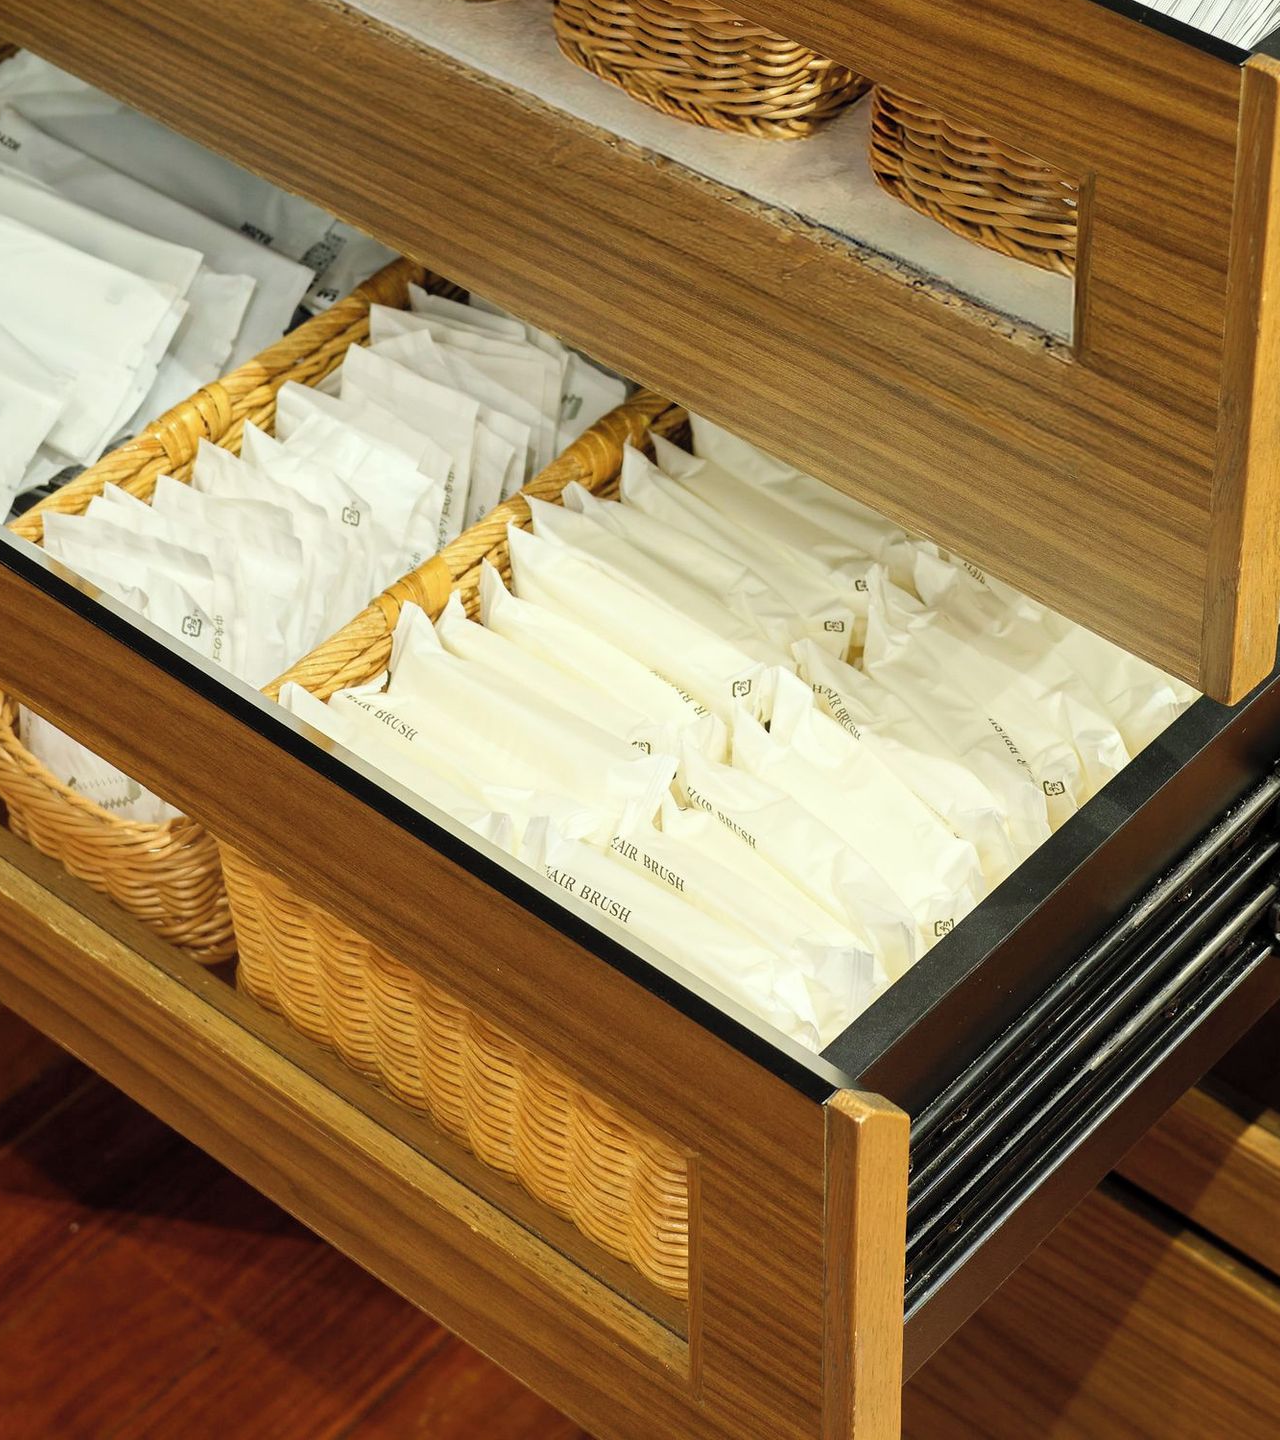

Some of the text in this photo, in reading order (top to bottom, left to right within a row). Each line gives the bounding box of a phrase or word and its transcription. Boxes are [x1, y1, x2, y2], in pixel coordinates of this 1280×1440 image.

[373, 709, 419, 741] BRUSH
[643, 854, 686, 893] BRUSH
[579, 884, 633, 923] BRUSH
